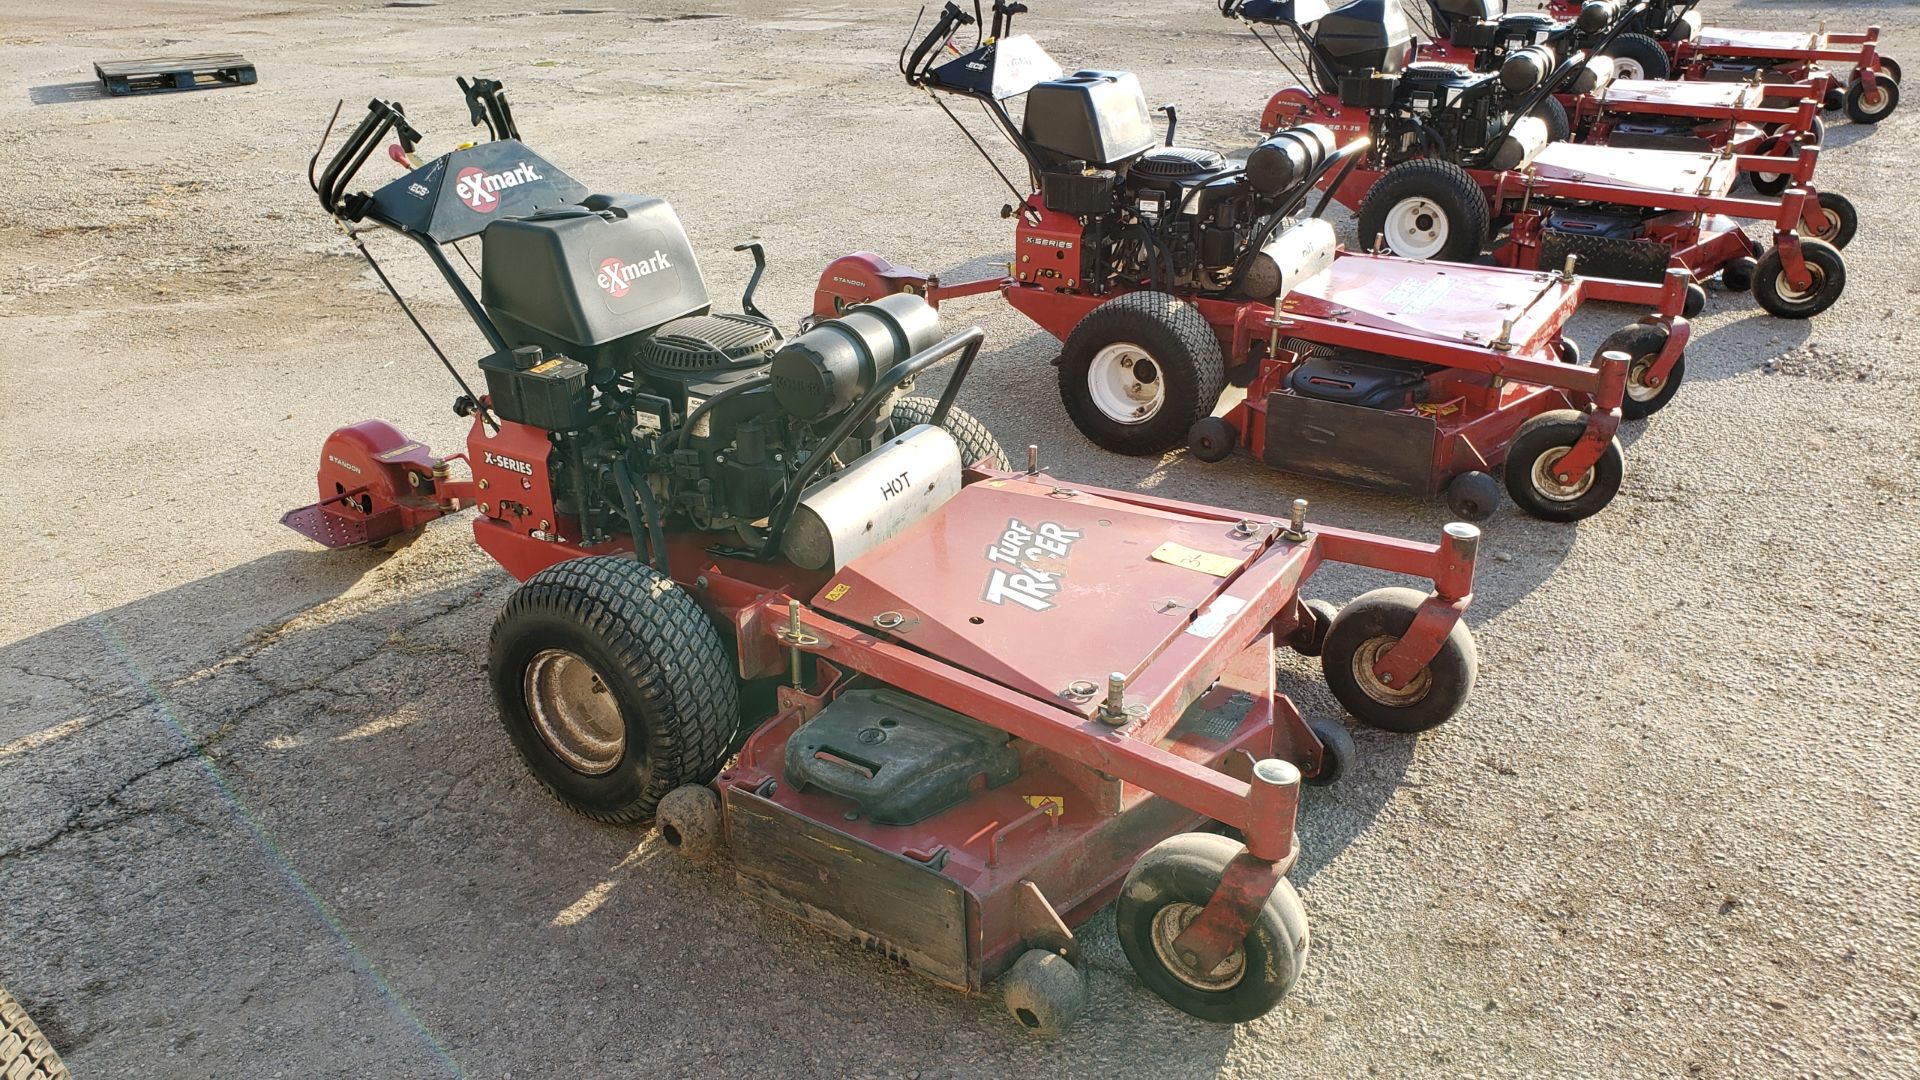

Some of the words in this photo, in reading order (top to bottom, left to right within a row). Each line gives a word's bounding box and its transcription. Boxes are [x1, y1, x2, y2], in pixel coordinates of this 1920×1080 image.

[1026, 236, 1073, 249] X-SERIES
[484, 451, 533, 476] X-SERIES
[880, 471, 910, 501] HOT
[987, 518, 1035, 565] TURF
